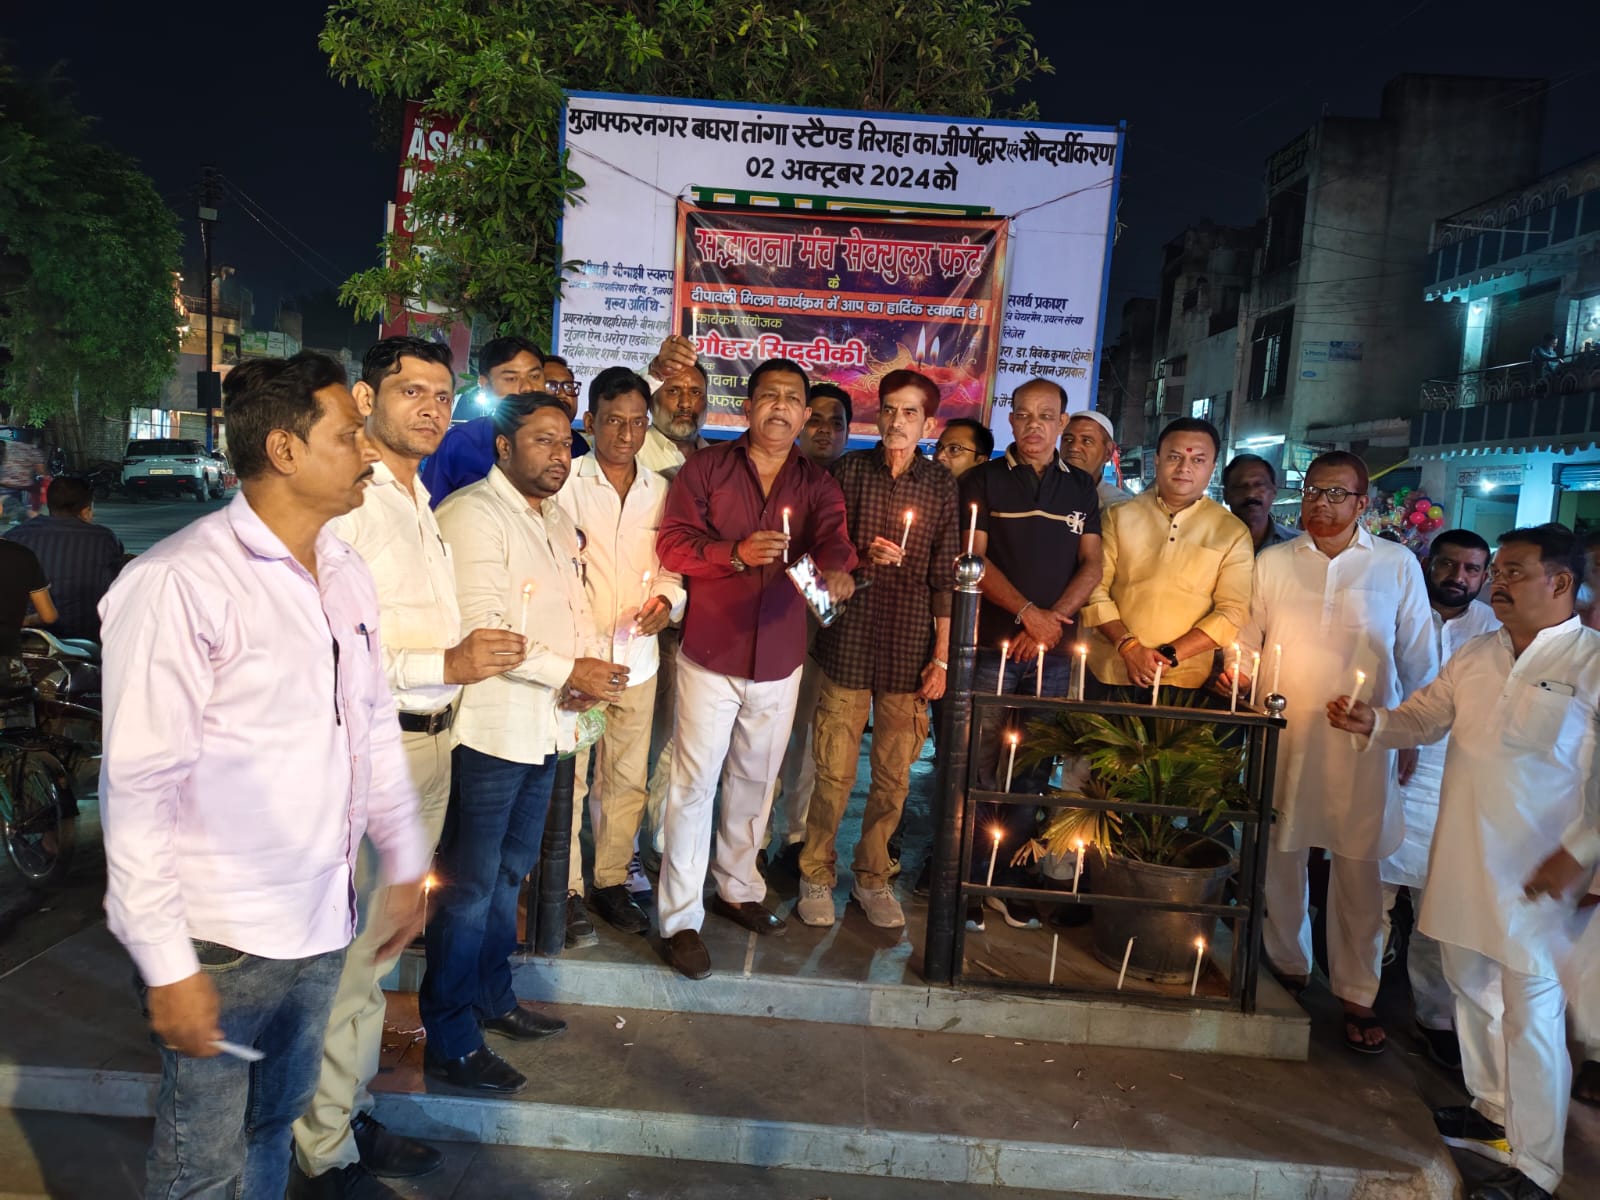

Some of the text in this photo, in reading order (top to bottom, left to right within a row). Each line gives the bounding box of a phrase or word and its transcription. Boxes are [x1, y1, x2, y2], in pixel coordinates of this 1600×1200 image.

[691, 117, 739, 143] बघरा
[741, 114, 789, 146] तांगा
[791, 116, 855, 150] स्टैण्ड
[858, 119, 911, 157] तिराहा
[913, 134, 938, 156] का
[746, 156, 958, 191] 02 अक्टूबर 2024 को
[797, 226, 839, 271] मंच
[827, 274, 841, 289] के
[691, 286, 737, 304] दीपावली
[740, 289, 774, 306] मिलन
[777, 292, 824, 311] कार्यक्रम
[826, 295, 840, 310] में
[841, 300, 864, 311] आप
[867, 301, 883, 313] का
[886, 298, 923, 316] हार्दिक
[926, 303, 966, 318] स्वागत
